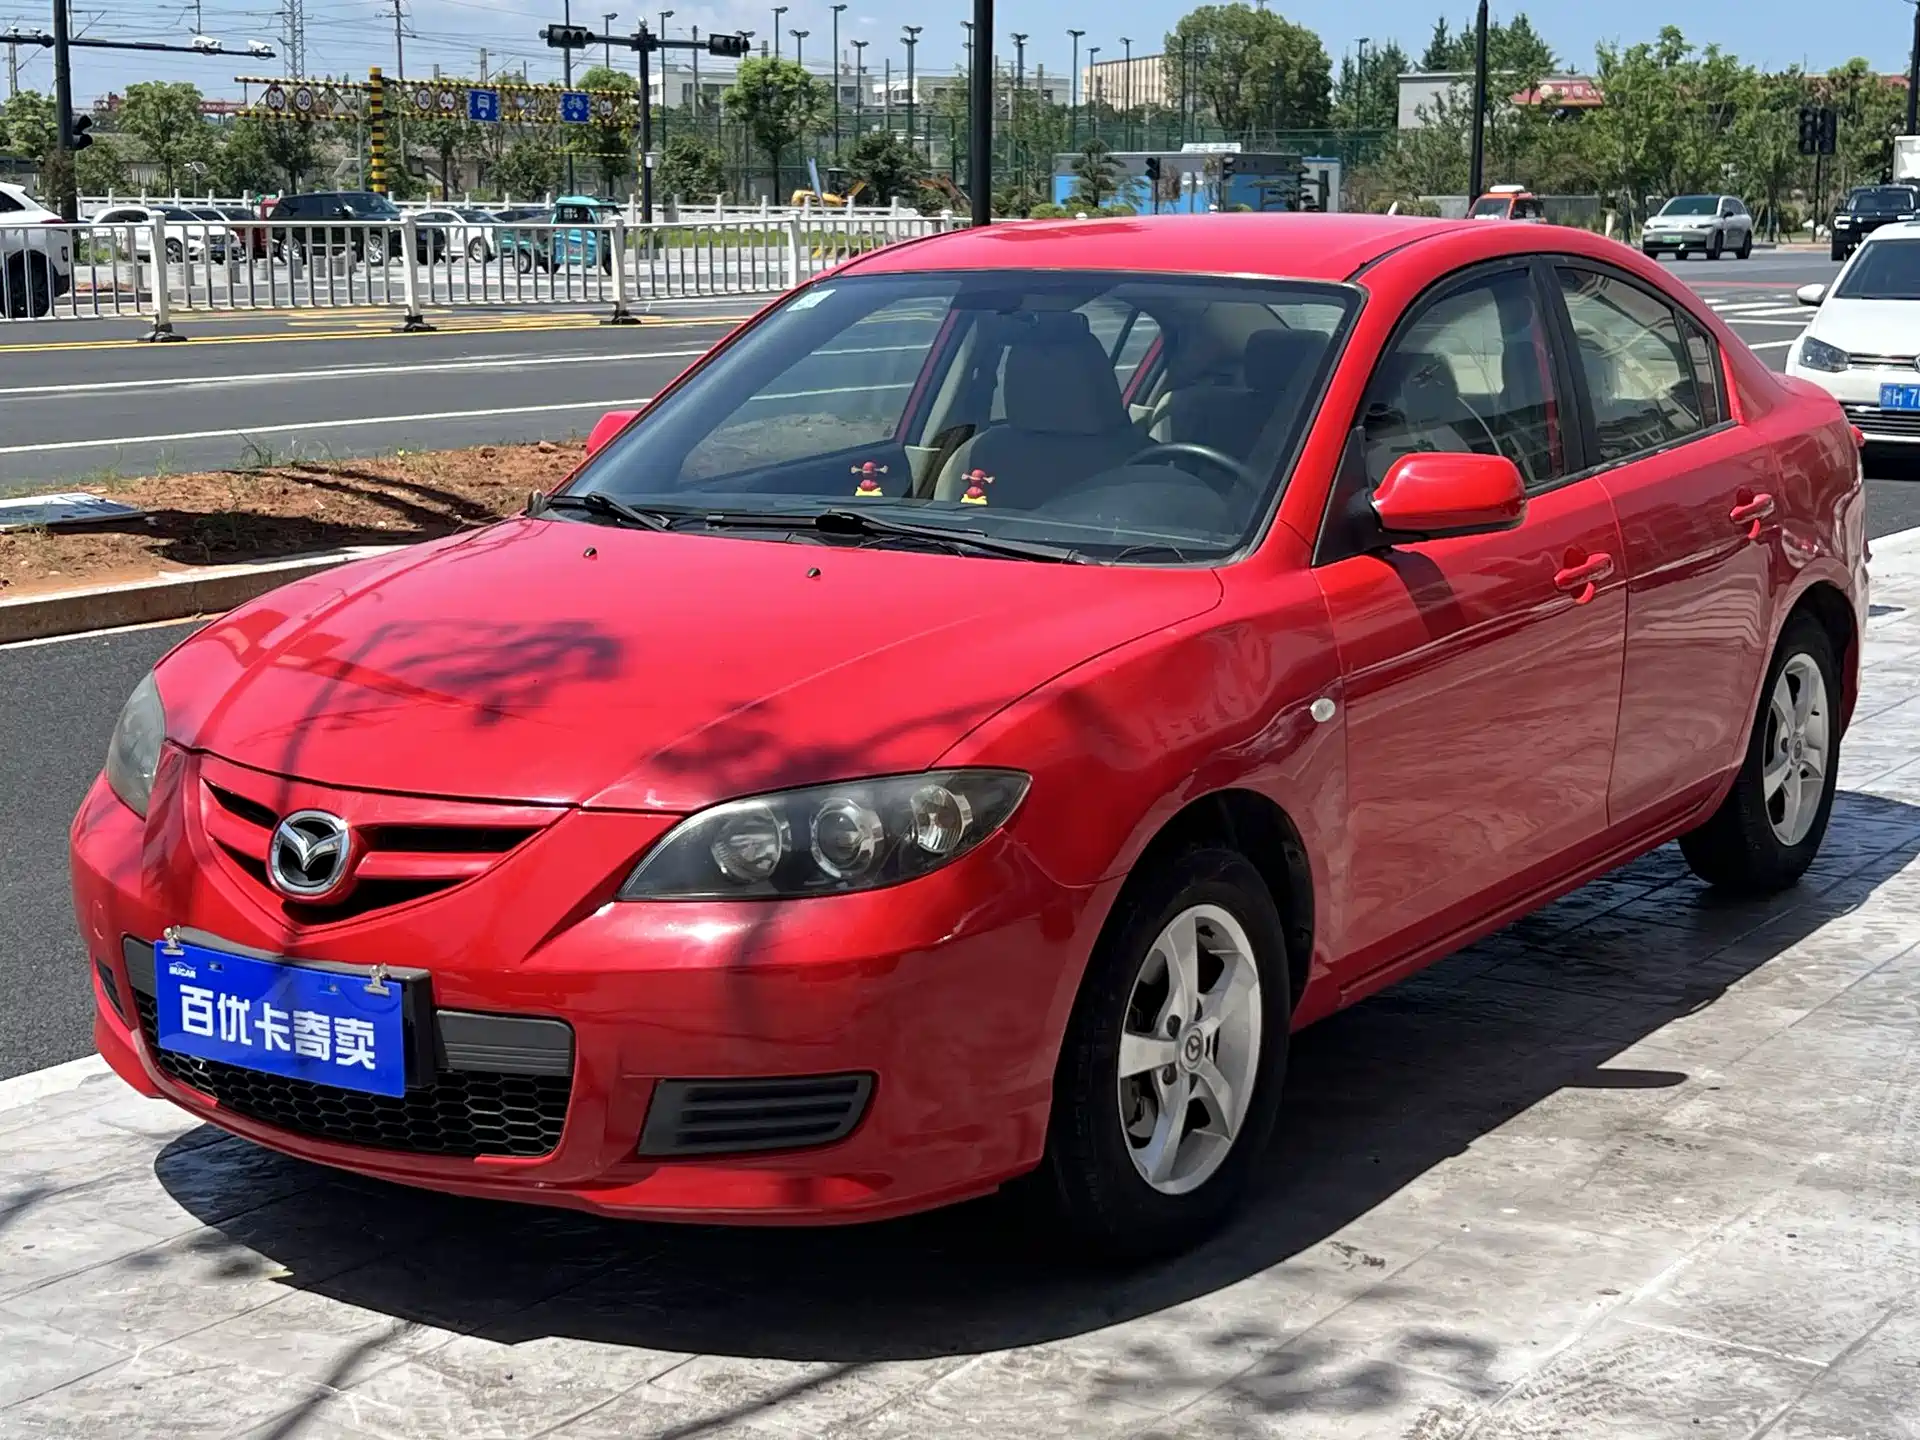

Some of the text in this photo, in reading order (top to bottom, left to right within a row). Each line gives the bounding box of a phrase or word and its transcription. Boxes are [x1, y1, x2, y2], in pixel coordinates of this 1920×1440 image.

[179, 983, 376, 1070] 百优卡寄卖
